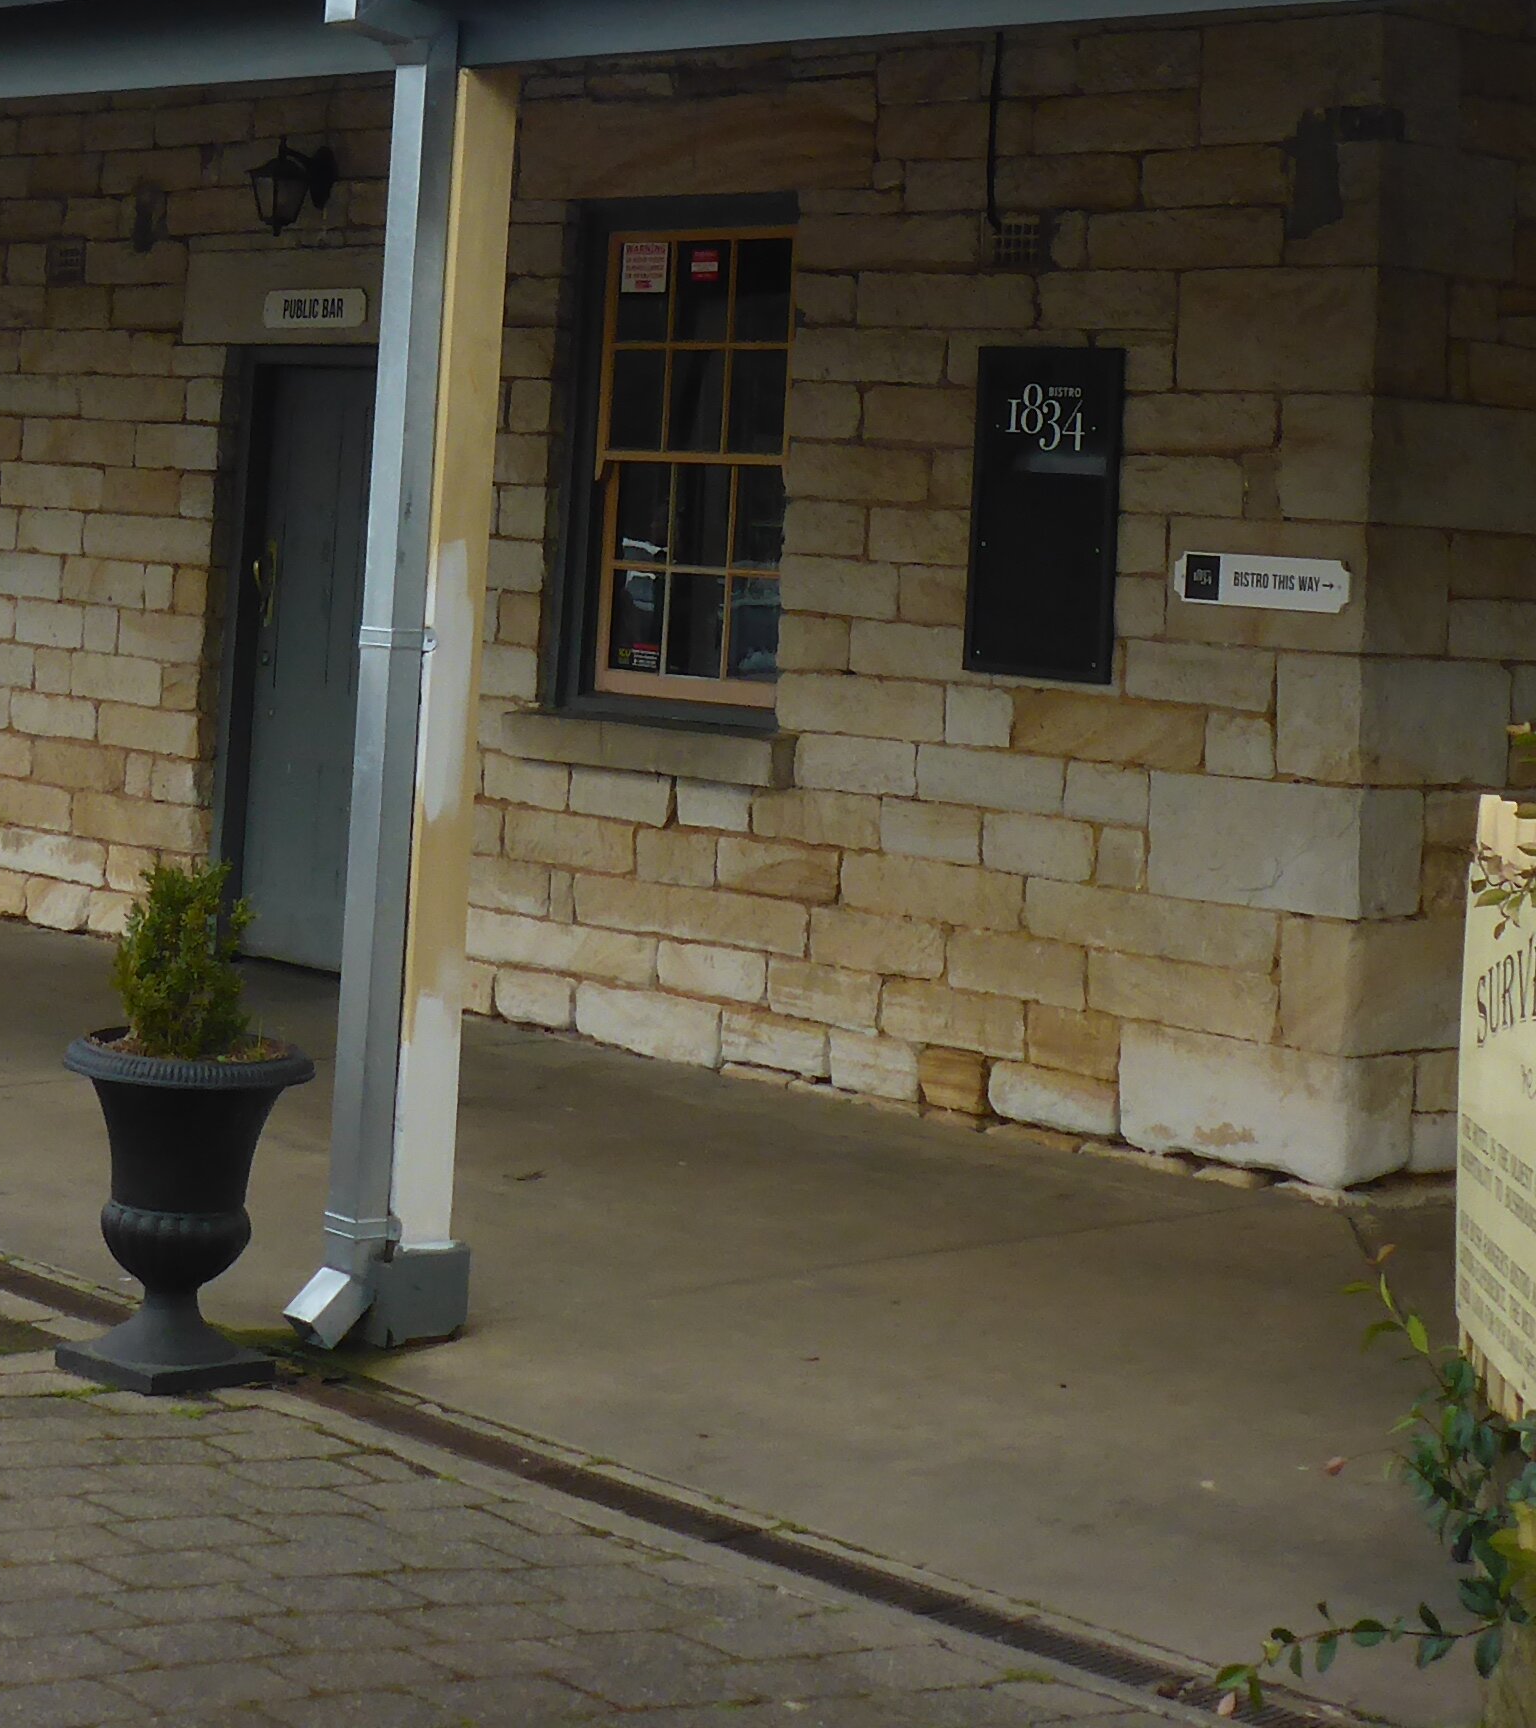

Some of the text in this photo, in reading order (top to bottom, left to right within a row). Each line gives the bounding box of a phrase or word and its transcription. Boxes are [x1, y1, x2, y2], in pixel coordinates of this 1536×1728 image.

[283, 297, 344, 319] PUBLIC BAR
[1048, 386, 1082, 398] BISTRO
[1005, 383, 1086, 452] 1834
[1233, 571, 1321, 592] BISTRO THIS WAY
